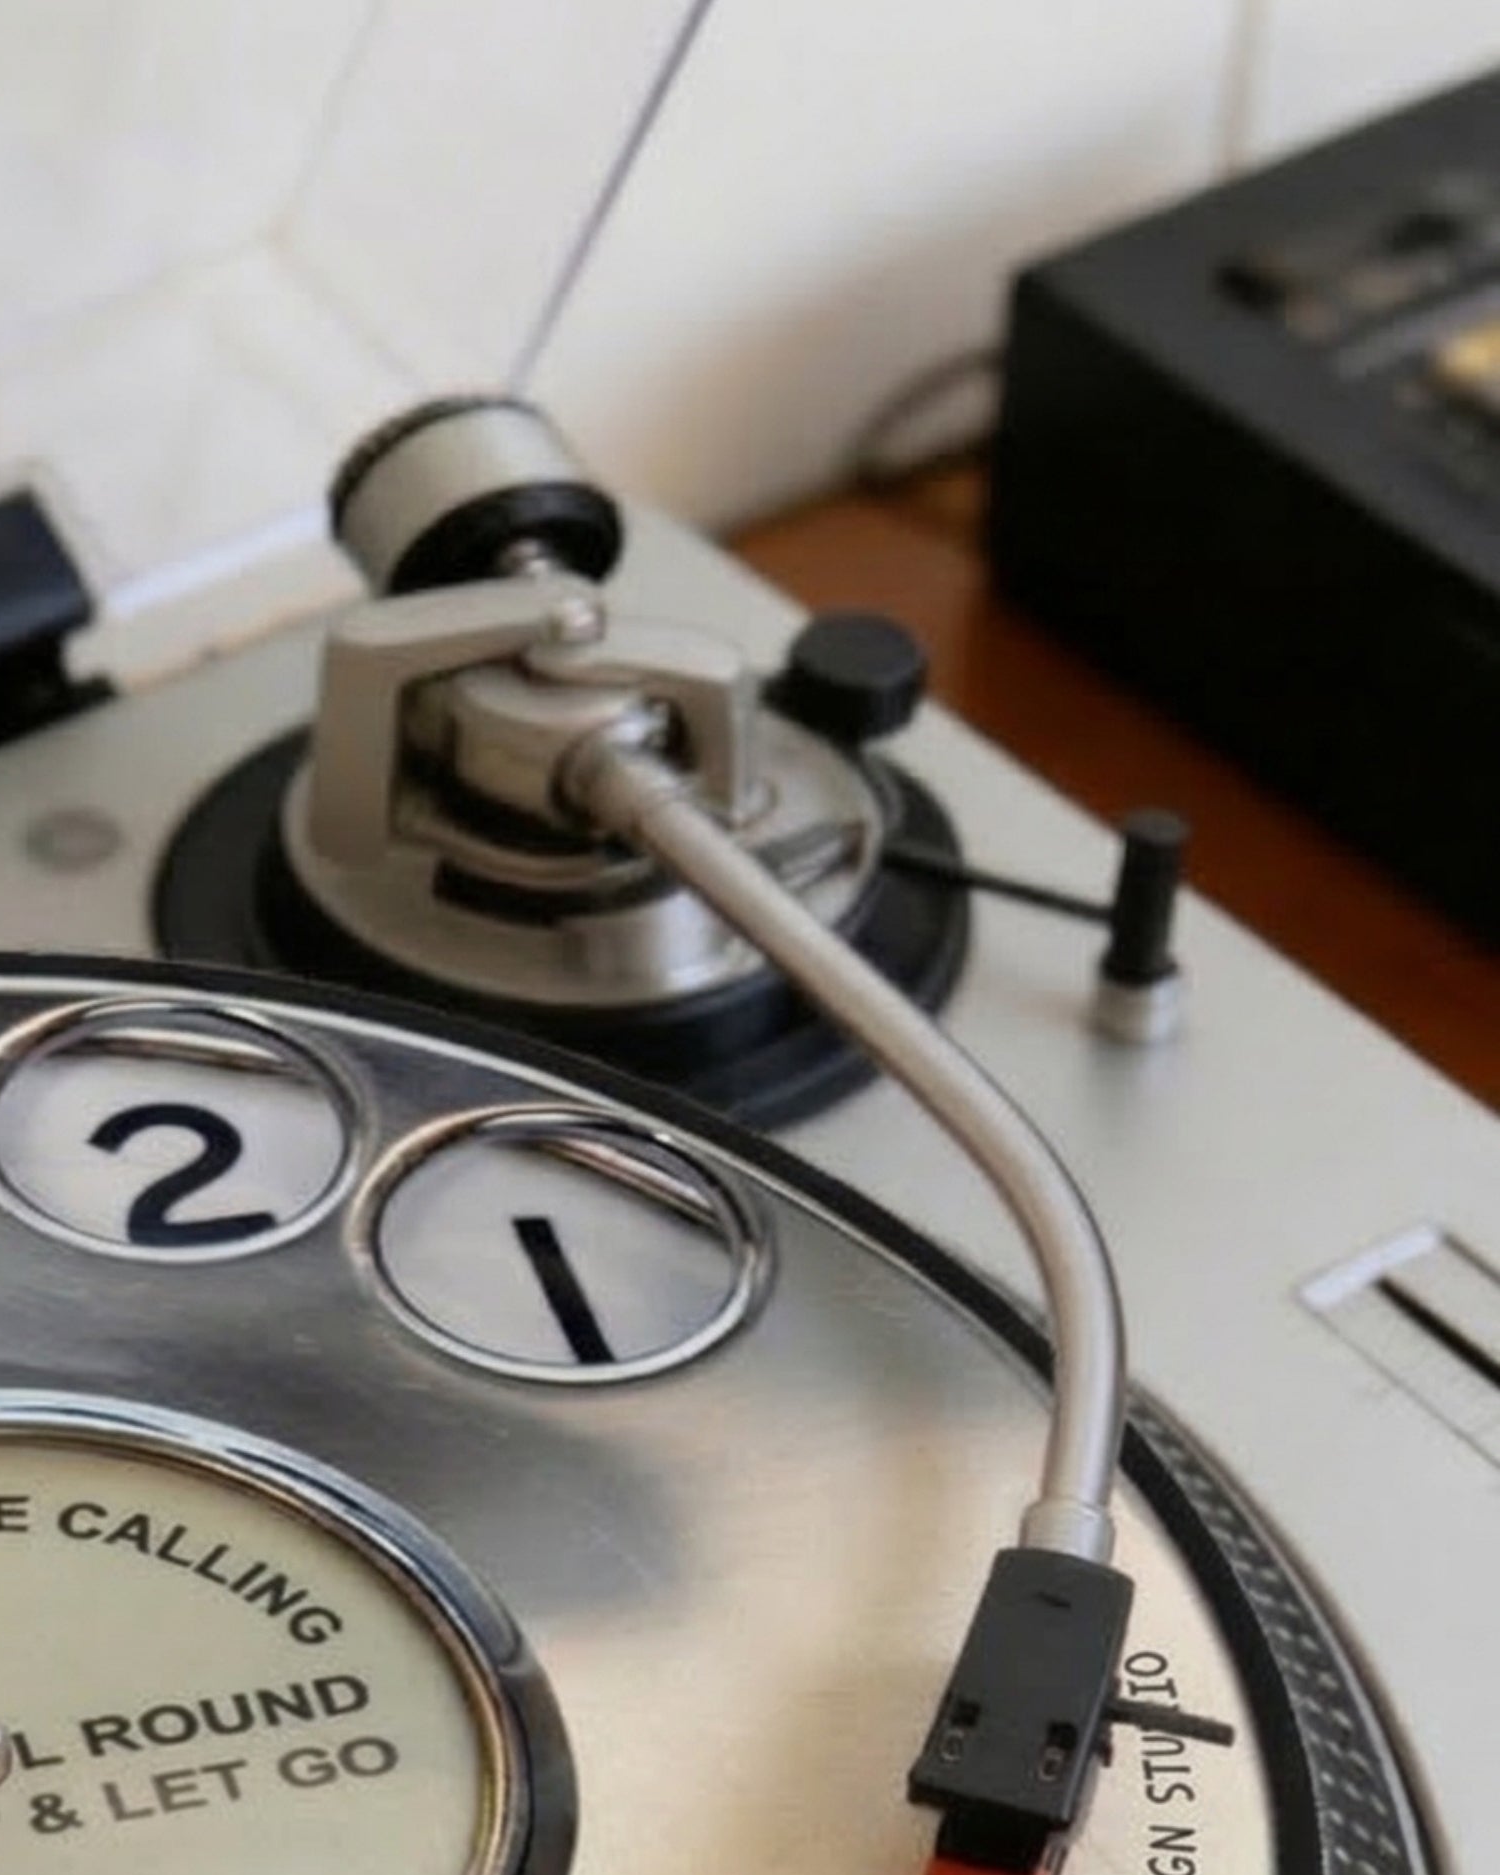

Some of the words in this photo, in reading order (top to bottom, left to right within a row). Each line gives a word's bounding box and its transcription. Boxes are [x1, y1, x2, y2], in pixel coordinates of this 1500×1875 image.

[89, 1104, 261, 1247] 2
[512, 1217, 616, 1365] 1
[56, 1501, 343, 1646] CALLING
[29, 1792, 84, 1835] &
[102, 1759, 247, 1822] LET
[277, 1736, 400, 1789] GO
[78, 1674, 370, 1758] ROUND
[1124, 1651, 1197, 1804] STUIO
